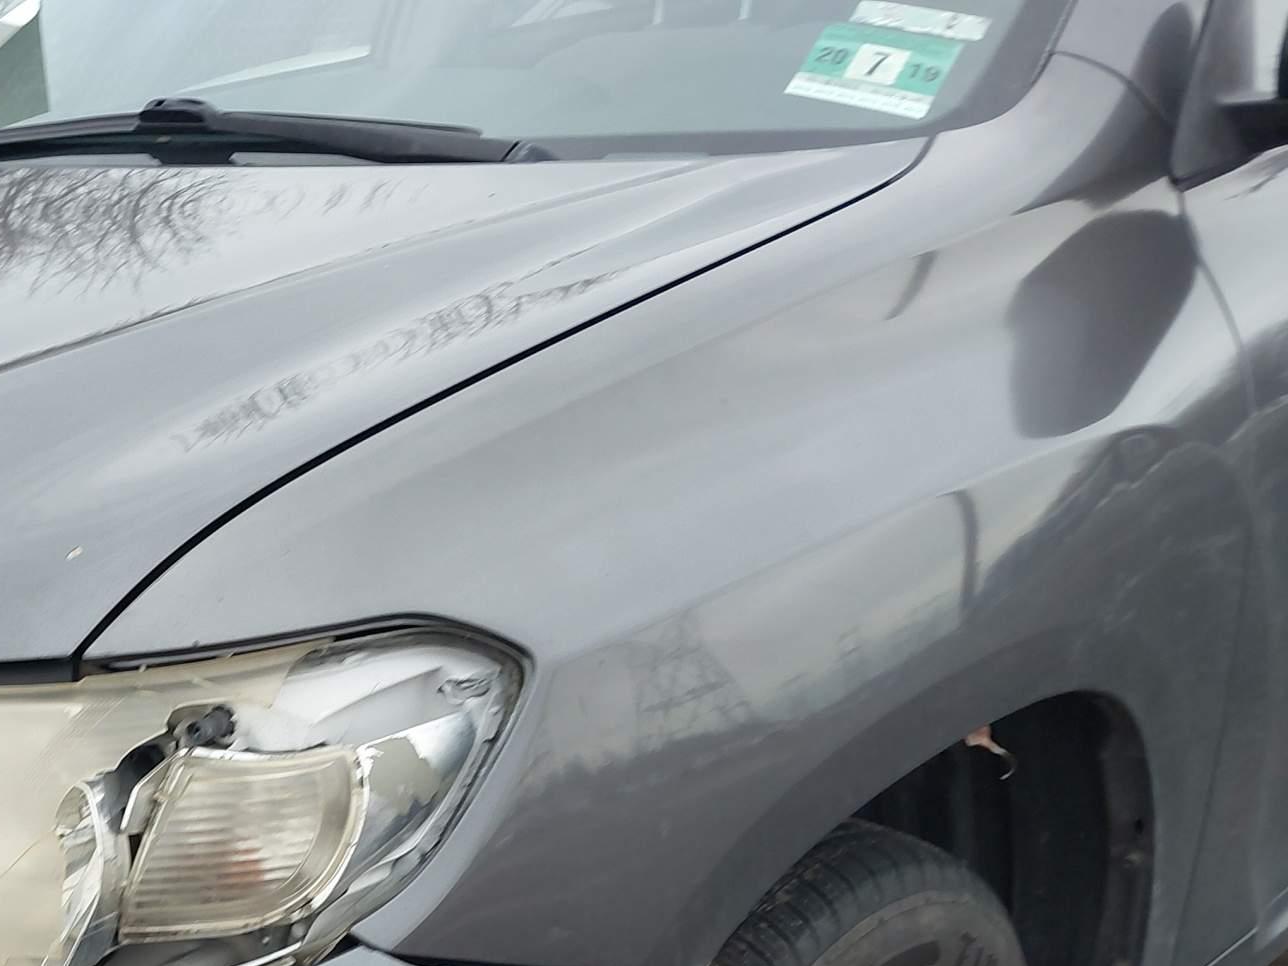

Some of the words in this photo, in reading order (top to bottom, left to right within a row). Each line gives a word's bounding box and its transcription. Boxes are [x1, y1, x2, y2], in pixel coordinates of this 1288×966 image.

[815, 46, 849, 65] 20
[865, 52, 889, 76] 7
[910, 62, 942, 82] 19
